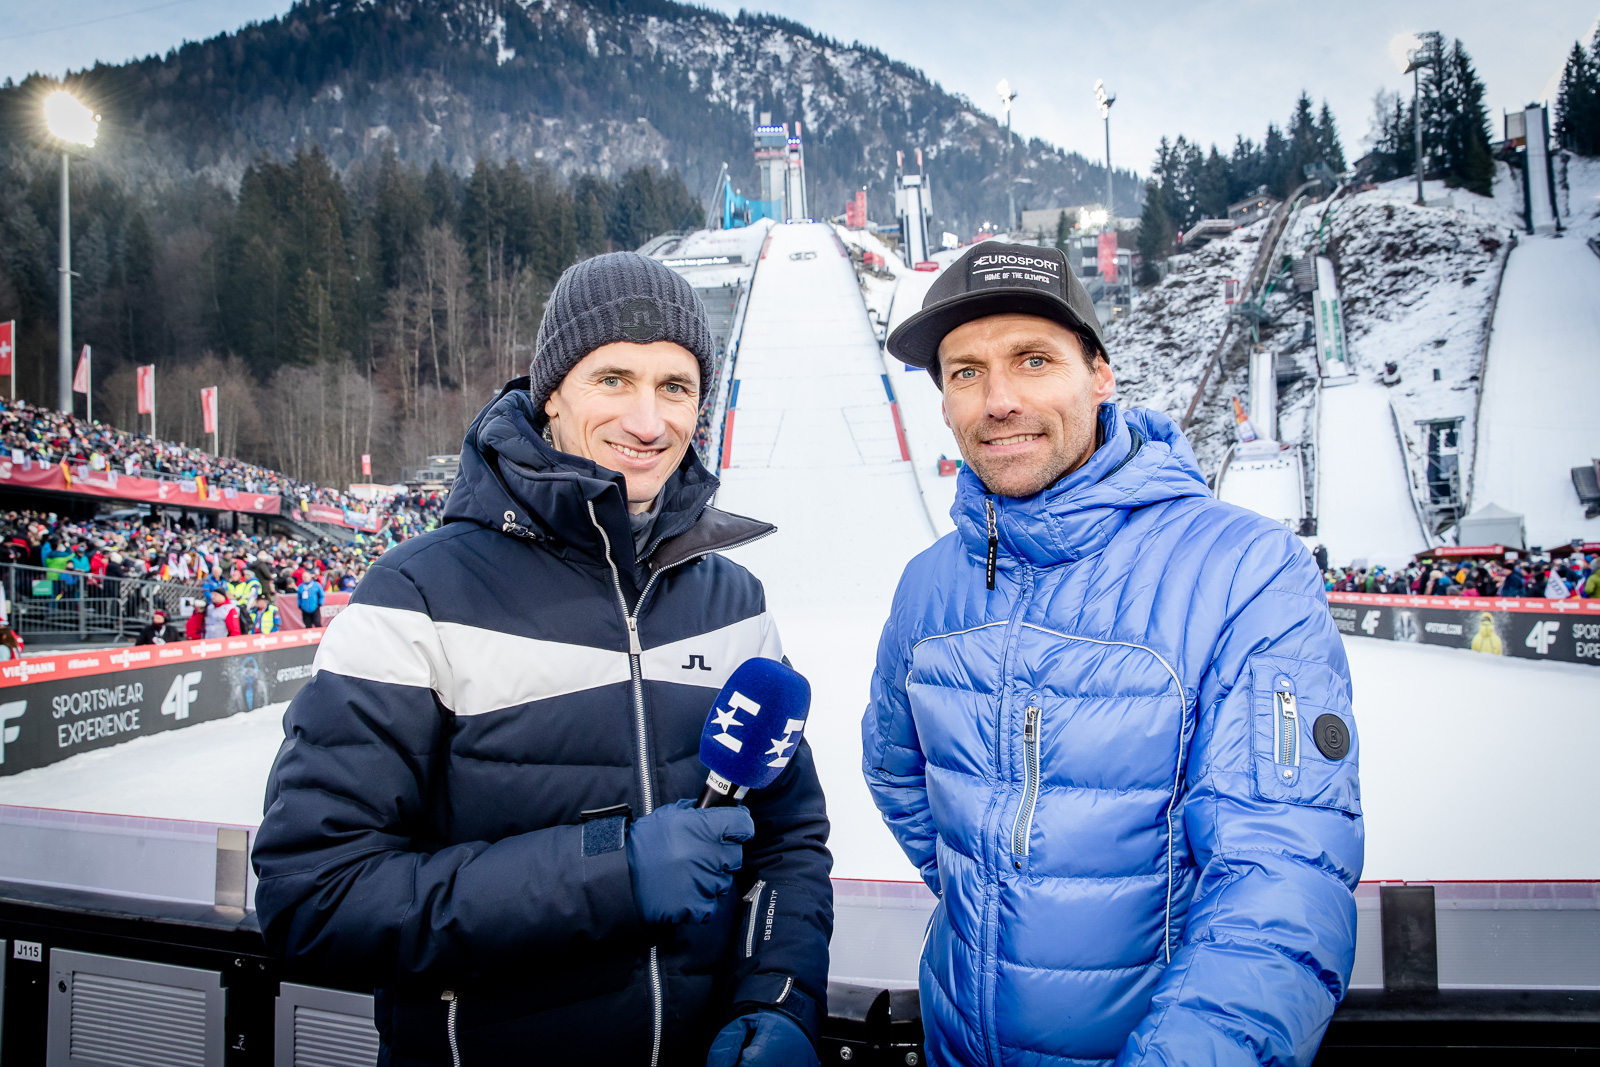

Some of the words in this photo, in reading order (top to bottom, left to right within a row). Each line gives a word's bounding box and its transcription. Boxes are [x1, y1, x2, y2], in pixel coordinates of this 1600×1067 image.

[974, 255, 1059, 271] EUROSPORT
[985, 273, 1001, 281] HOME
[1025, 273, 1050, 283] OLYMPICS
[1361, 610, 1381, 635] 4F
[1525, 621, 1560, 654] 4F
[52, 682, 144, 719] SPORTSWEAR
[161, 671, 203, 721] 4F
[58, 709, 140, 748] EXPERIENCE
[17, 944, 39, 958] J115
